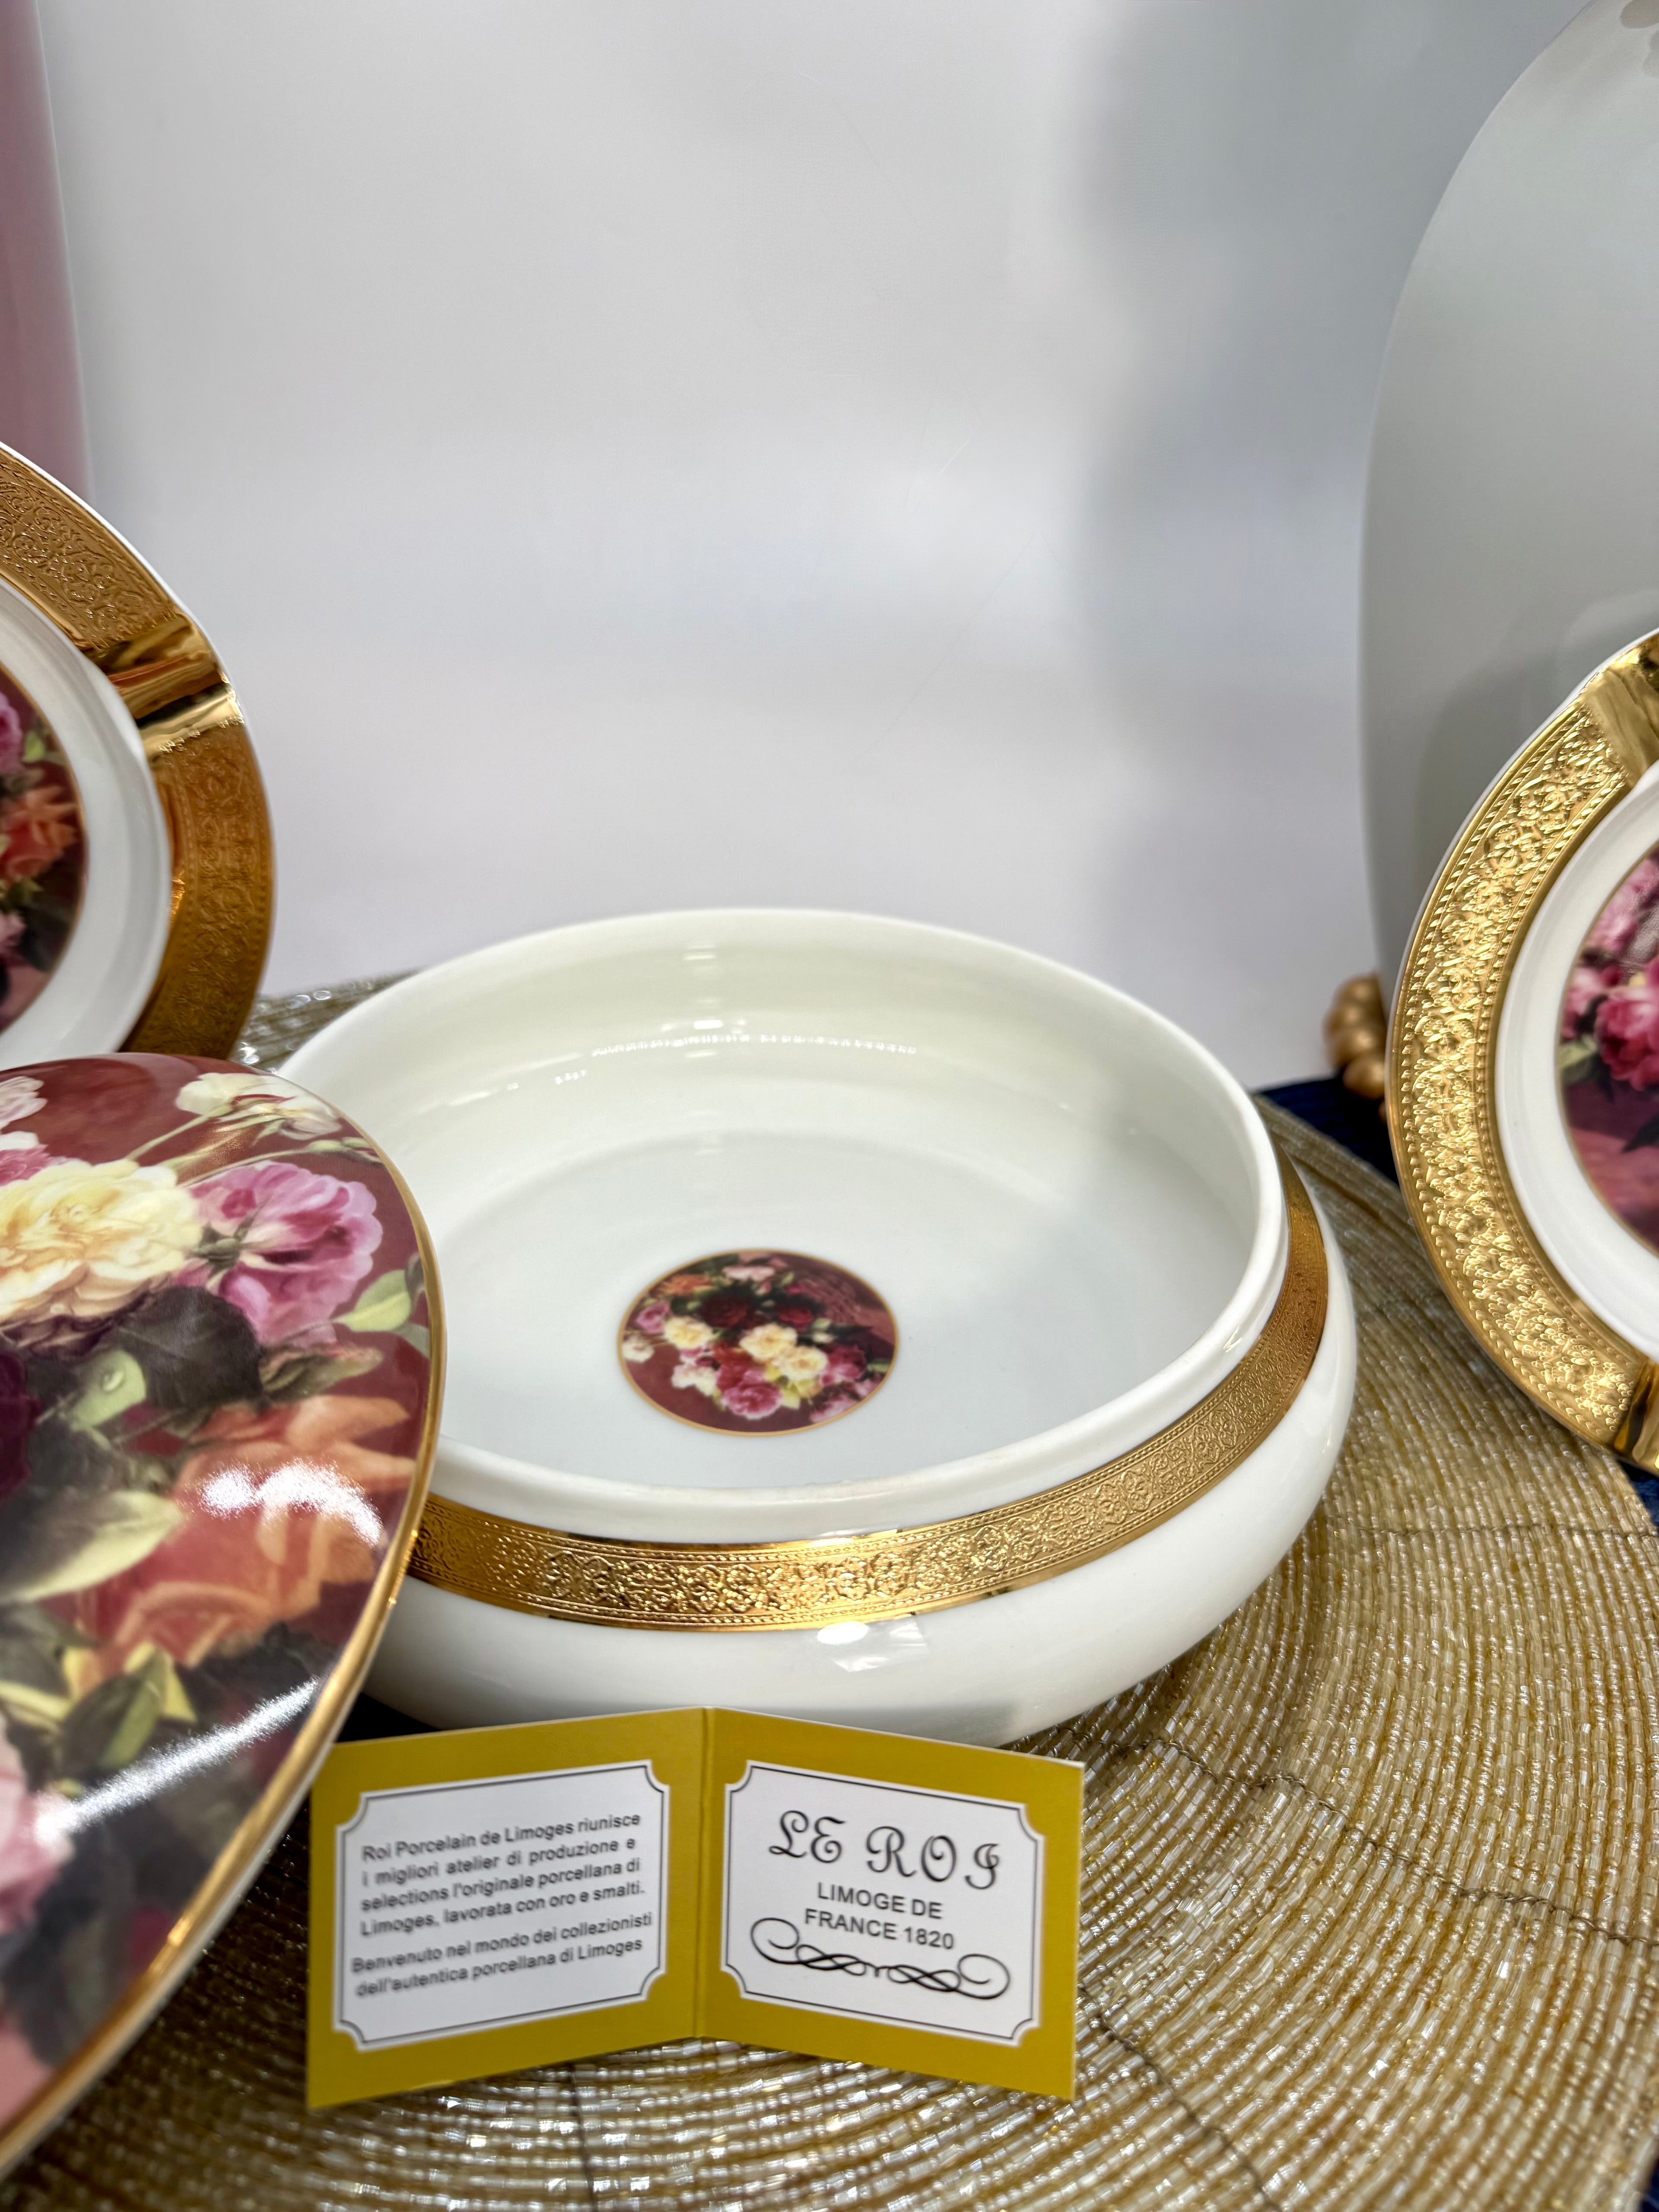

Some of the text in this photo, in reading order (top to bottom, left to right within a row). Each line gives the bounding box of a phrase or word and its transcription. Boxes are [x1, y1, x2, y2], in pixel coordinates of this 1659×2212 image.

[395, 1835, 476, 1856] Porcelain
[480, 1831, 501, 1845] de
[505, 1823, 574, 1841] Limoges
[577, 1813, 640, 1832] riunisce
[769, 1810, 846, 1863] LE
[375, 1862, 439, 1885] migliori
[446, 1857, 499, 1875] atelier
[507, 1853, 521, 1866] di
[529, 1840, 618, 1865] produzione
[626, 1838, 636, 1849] e
[361, 1886, 448, 1912] selections
[538, 1862, 622, 1888] porcellana
[626, 1858, 640, 1872] di
[443, 1899, 512, 1923] lavorata
[516, 1899, 545, 1912] con
[549, 1893, 575, 1906] oro
[579, 1891, 588, 1901] e
[593, 1880, 644, 1900] smalti.
[817, 1881, 942, 1919] LIMOGE DE
[352, 1948, 442, 1973] Benvenuto
[475, 1933, 529, 1953] mondo
[533, 1929, 557, 1944] dei
[561, 1912, 652, 1939] collezionisti
[804, 1908, 955, 1949] FRANCE 1820
[471, 1955, 555, 1979] porcellana
[560, 1948, 574, 1962] di
[577, 1938, 643, 1960] Limoges
